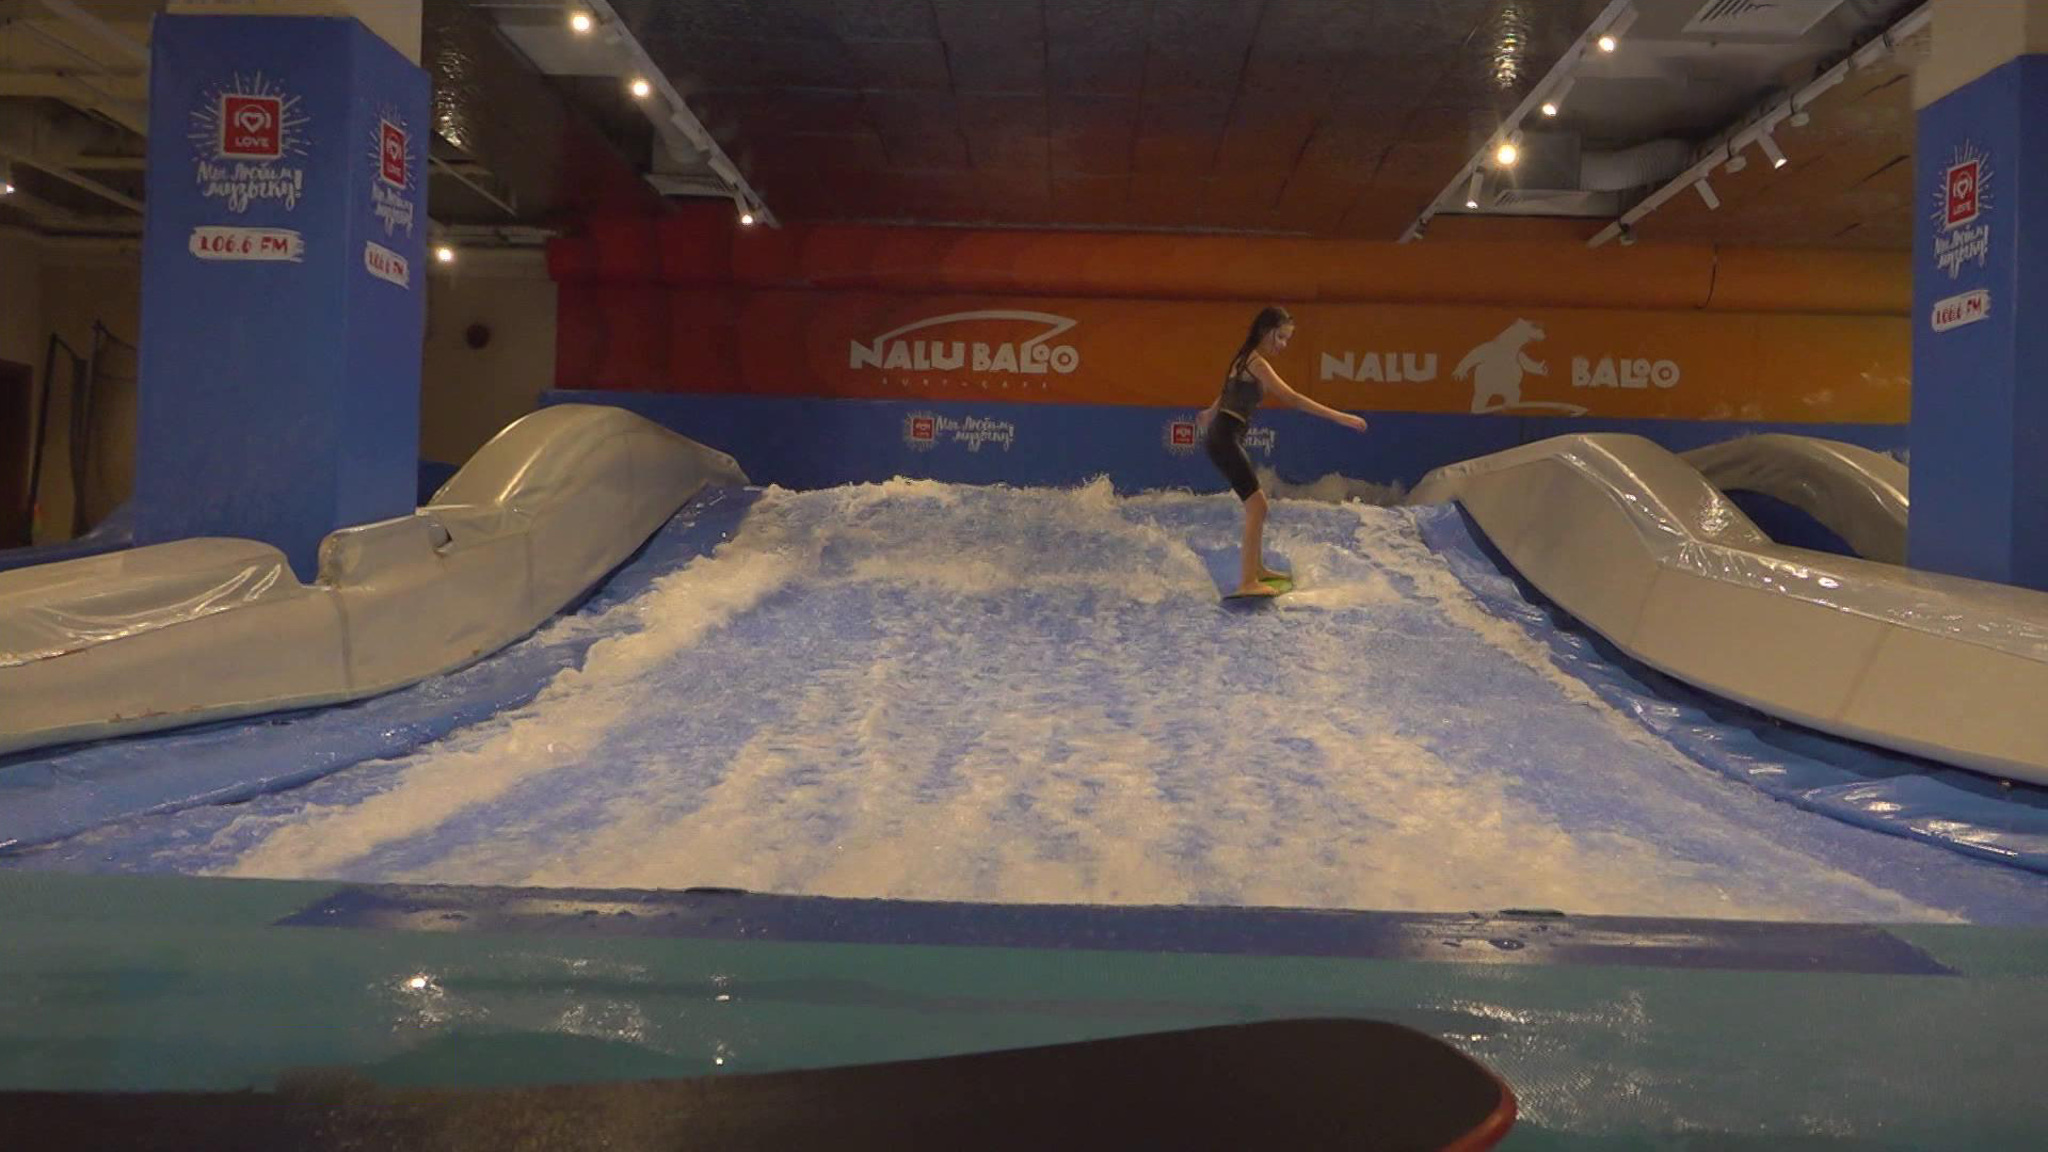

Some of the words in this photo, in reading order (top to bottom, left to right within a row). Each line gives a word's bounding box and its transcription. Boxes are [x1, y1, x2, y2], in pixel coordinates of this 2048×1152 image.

[234, 136, 270, 148] LOVE
[200, 235, 252, 254] 106.6
[260, 236, 288, 253] FM
[850, 339, 965, 371] NALU
[972, 341, 1080, 374] BALOO
[1320, 351, 1438, 383] NALU
[1571, 355, 1681, 389] BALOO
